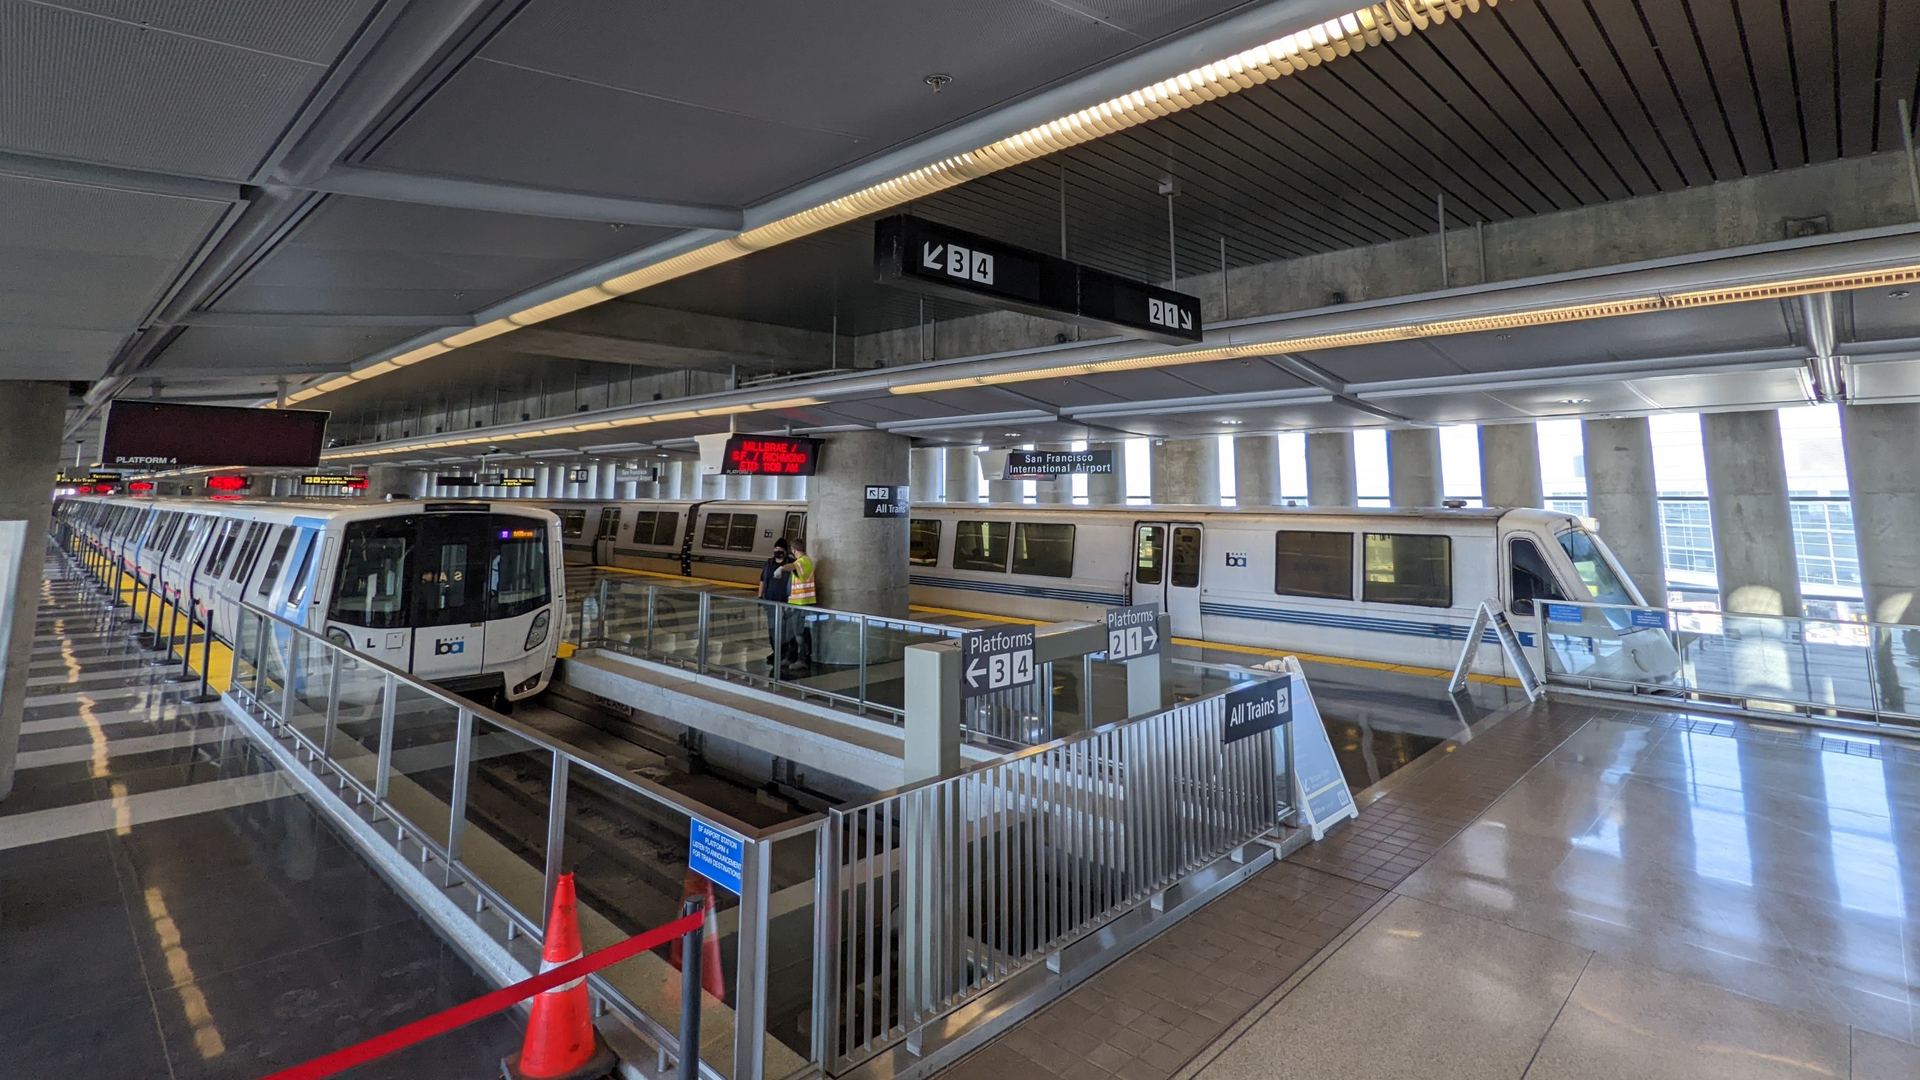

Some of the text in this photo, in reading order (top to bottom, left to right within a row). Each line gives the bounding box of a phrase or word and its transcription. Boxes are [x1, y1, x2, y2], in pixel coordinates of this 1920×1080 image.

[952, 250, 988, 279] 3 4
[1152, 303, 1174, 324] 2 1
[743, 441, 788, 453] MILLBRAE
[763, 452, 806, 463] RICHMOND
[1025, 453, 1094, 463] San Francisco
[785, 463, 799, 473] AM
[1009, 463, 1111, 474] International Airport
[881, 490, 886, 498] 2
[875, 503, 887, 513] All
[1108, 610, 1154, 628] Platforms
[367, 638, 376, 649] L
[970, 632, 1033, 654] Platforms
[1112, 634, 1122, 655] 2
[995, 655, 1029, 683] 3 4
[1230, 697, 1275, 727] All Trains
[704, 837, 726, 852] PLATFORM
[720, 836, 737, 850] STATION
[692, 848, 742, 880] FOR TRAIN DESTINATIONS
